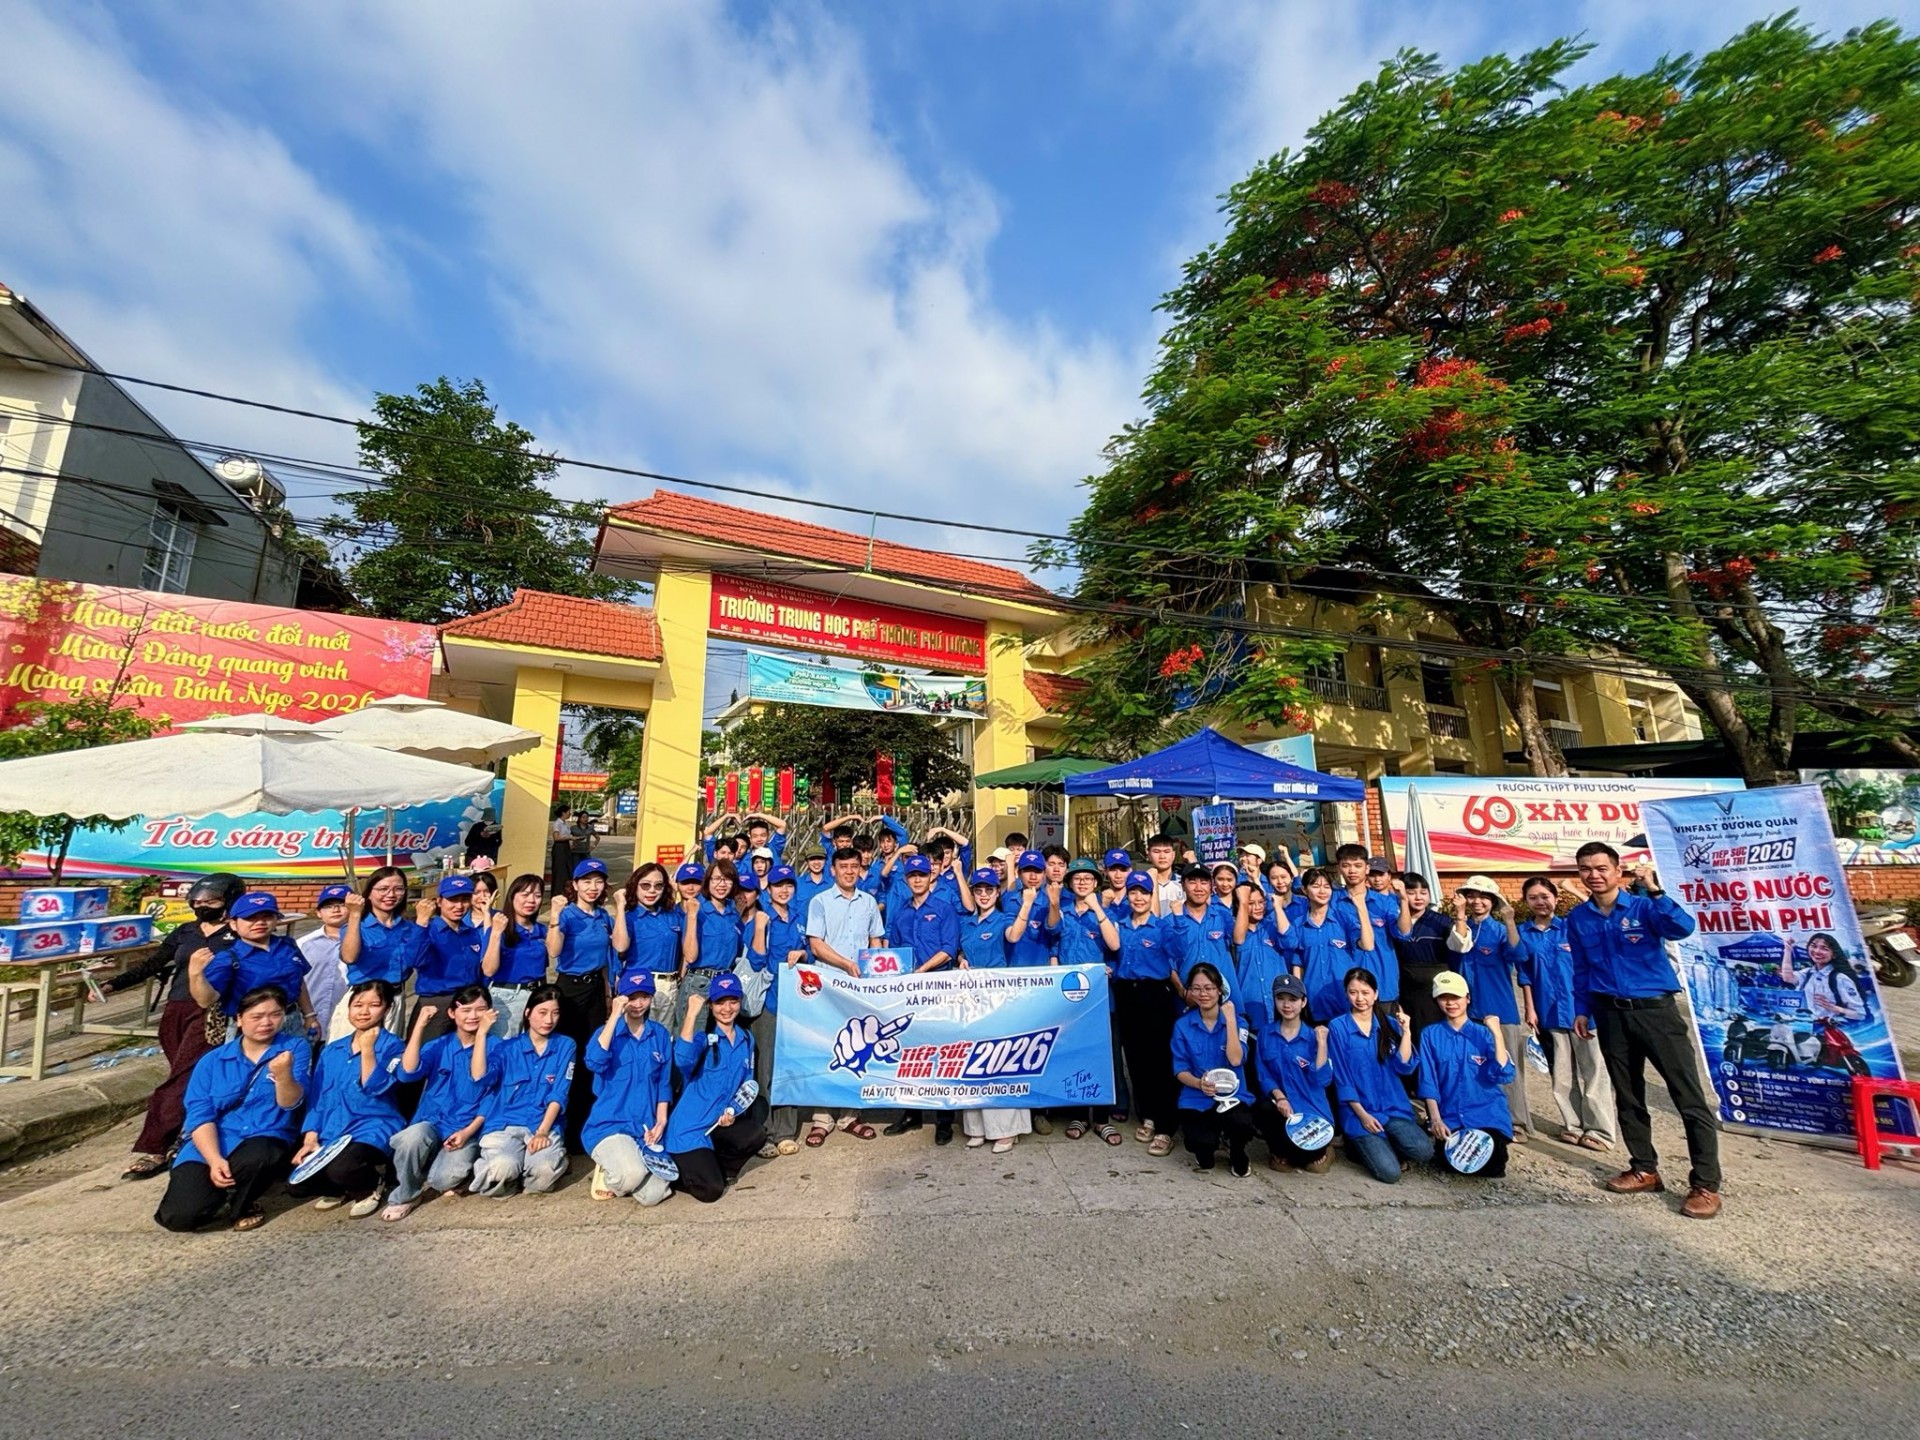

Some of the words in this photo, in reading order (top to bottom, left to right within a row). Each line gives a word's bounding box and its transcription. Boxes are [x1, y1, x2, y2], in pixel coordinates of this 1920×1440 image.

[61, 601, 142, 643] Mừng
[151, 607, 199, 635] đất
[200, 620, 261, 643] nước
[265, 622, 305, 647] đổi
[307, 630, 352, 652] mới
[719, 595, 775, 624] TRƯỜNG
[777, 605, 821, 632] TRUNG
[824, 614, 849, 638] HỌC
[920, 630, 943, 652] PHÚ
[48, 633, 135, 669] Mừng
[142, 640, 214, 677] Đảng
[217, 654, 295, 684] quang
[299, 660, 351, 681] vinh
[0, 663, 87, 699] Mừng
[173, 675, 234, 704] Bính
[238, 682, 294, 715] Ngọ
[300, 690, 377, 714] 2026
[1546, 783, 1572, 792] THPT
[1199, 816, 1229, 826] VINFAST
[1462, 795, 1517, 836] 60
[1524, 799, 1589, 822] XÂY
[1598, 803, 1640, 825] DỰ
[1674, 822, 1718, 834] VINFAST
[1721, 819, 1762, 831] DƯƠNG
[1765, 816, 1798, 828] QUÂN
[143, 817, 217, 849] Tỏa
[224, 826, 305, 858] sáng
[1750, 840, 1794, 863] 2026
[1679, 878, 1748, 908] TẶNG
[1754, 871, 1833, 901] NƯỚC
[36, 898, 60, 913] 3A
[146, 902, 168, 920] C2
[1697, 901, 1773, 933] MIỄN
[1778, 902, 1833, 931] PHÍ
[33, 932, 63, 950] 3A
[112, 926, 139, 942] 3A
[873, 956, 898, 973] 3A
[832, 979, 861, 993] ĐOÀN
[862, 983, 887, 994] TNCS
[907, 980, 923, 992] CHÍ
[925, 980, 952, 990] MINH
[959, 979, 977, 992] HỘI
[1006, 976, 1029, 990] VIỆT
[1030, 977, 1054, 986] NAM
[906, 994, 919, 1006] XÃ
[921, 993, 942, 1005] PHÚ
[902, 1044, 938, 1062] TIẾP
[939, 1040, 974, 1061] SỨC
[965, 1032, 1053, 1076] 2026
[897, 1061, 933, 1078] MÙA
[936, 1060, 965, 1078] THI
[861, 1085, 882, 1098] HÃY
[883, 1086, 897, 1098] TỰ
[917, 1085, 951, 1097] CHÚNG
[952, 1085, 968, 1096] TÔI
[969, 1085, 980, 1096] ĐI
[981, 1084, 1009, 1096] CÙNG
[1010, 1084, 1030, 1097] BẠN
